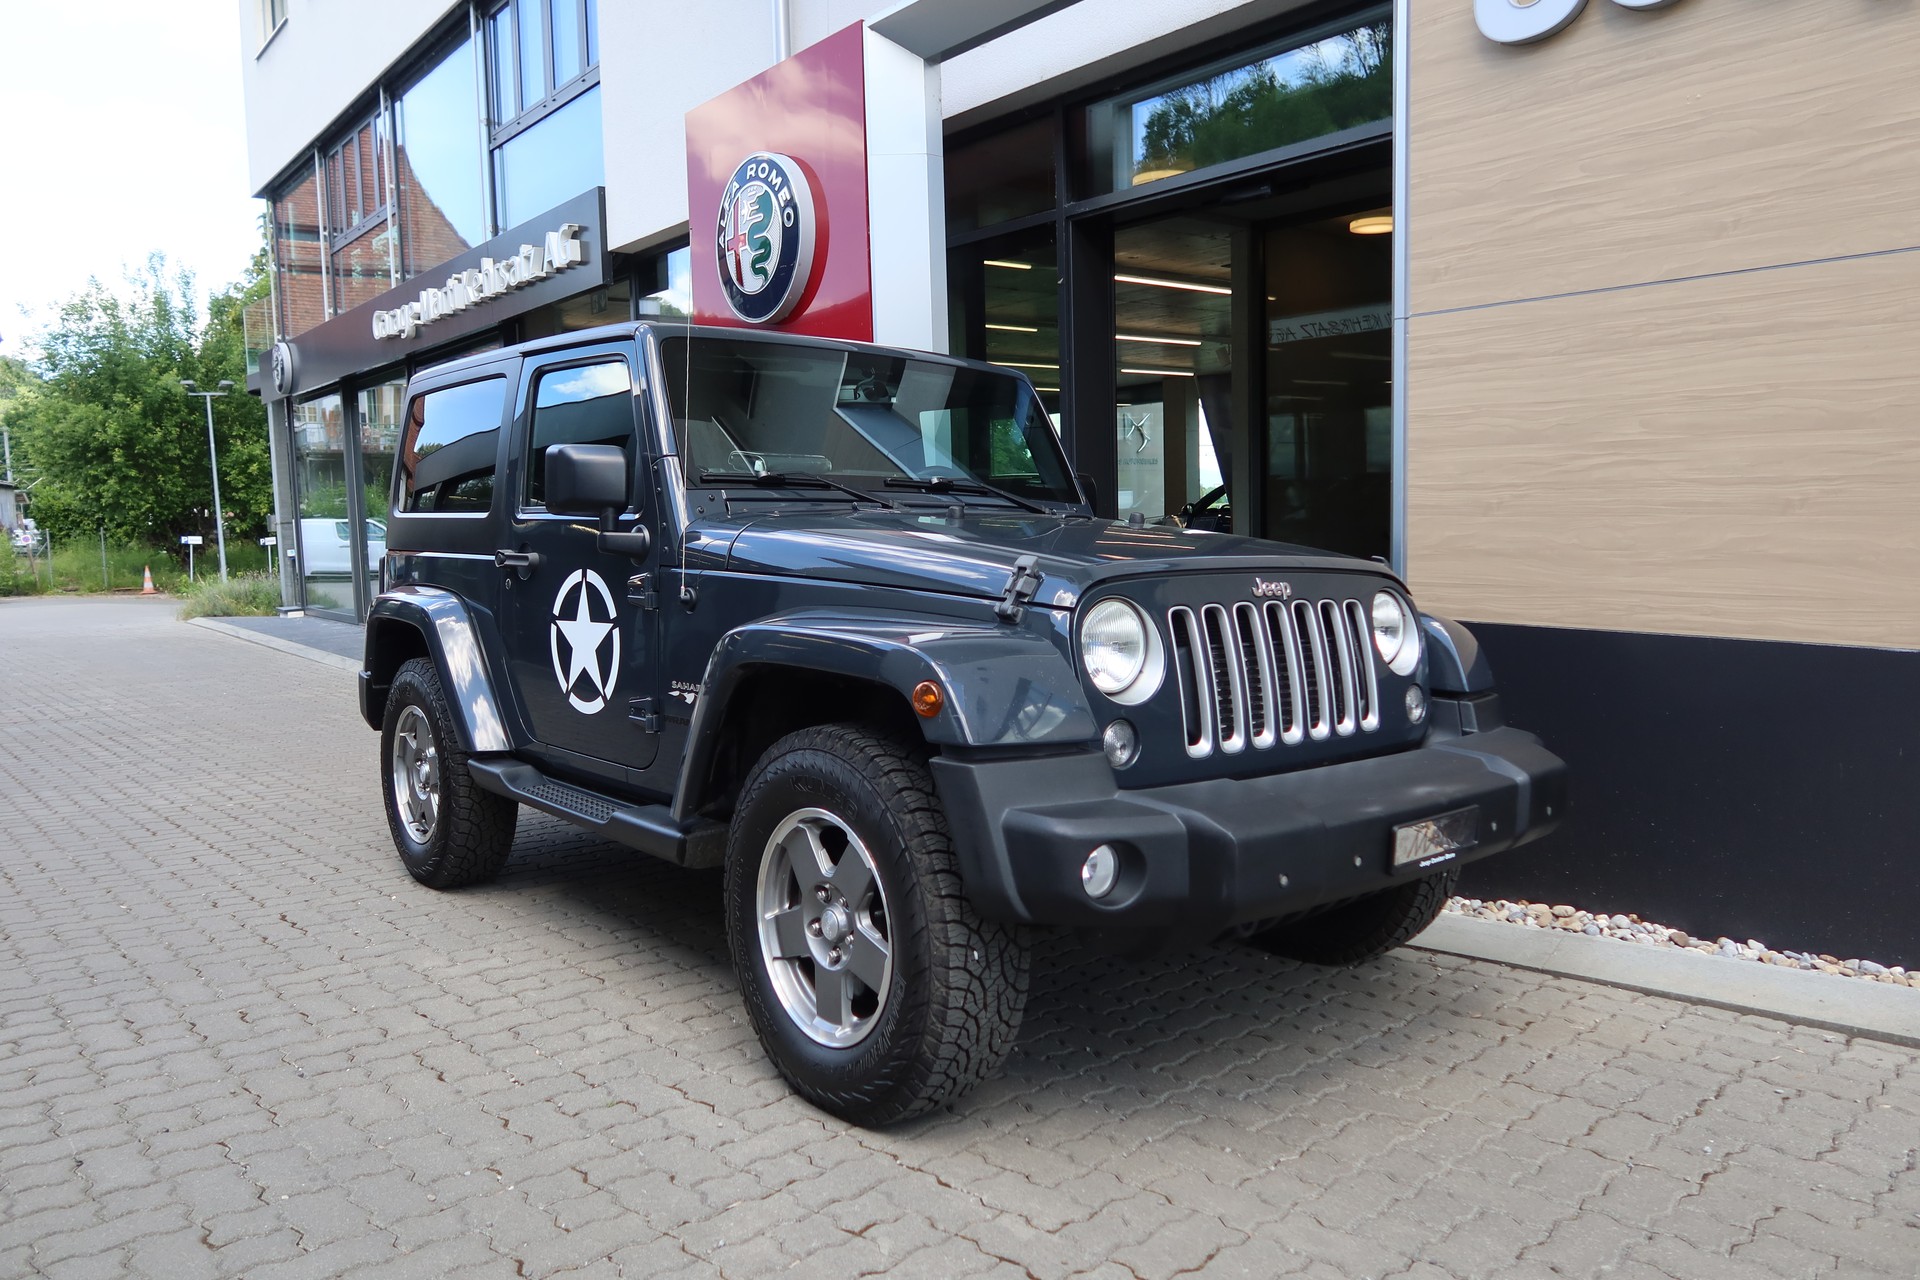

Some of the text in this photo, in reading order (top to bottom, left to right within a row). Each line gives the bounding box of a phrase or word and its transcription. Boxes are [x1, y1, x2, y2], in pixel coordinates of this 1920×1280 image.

[719, 163, 795, 249] ALFA ROMEO
[372, 302, 423, 340] Garage
[544, 223, 582, 273] AG
[1251, 577, 1292, 600] Jeep
